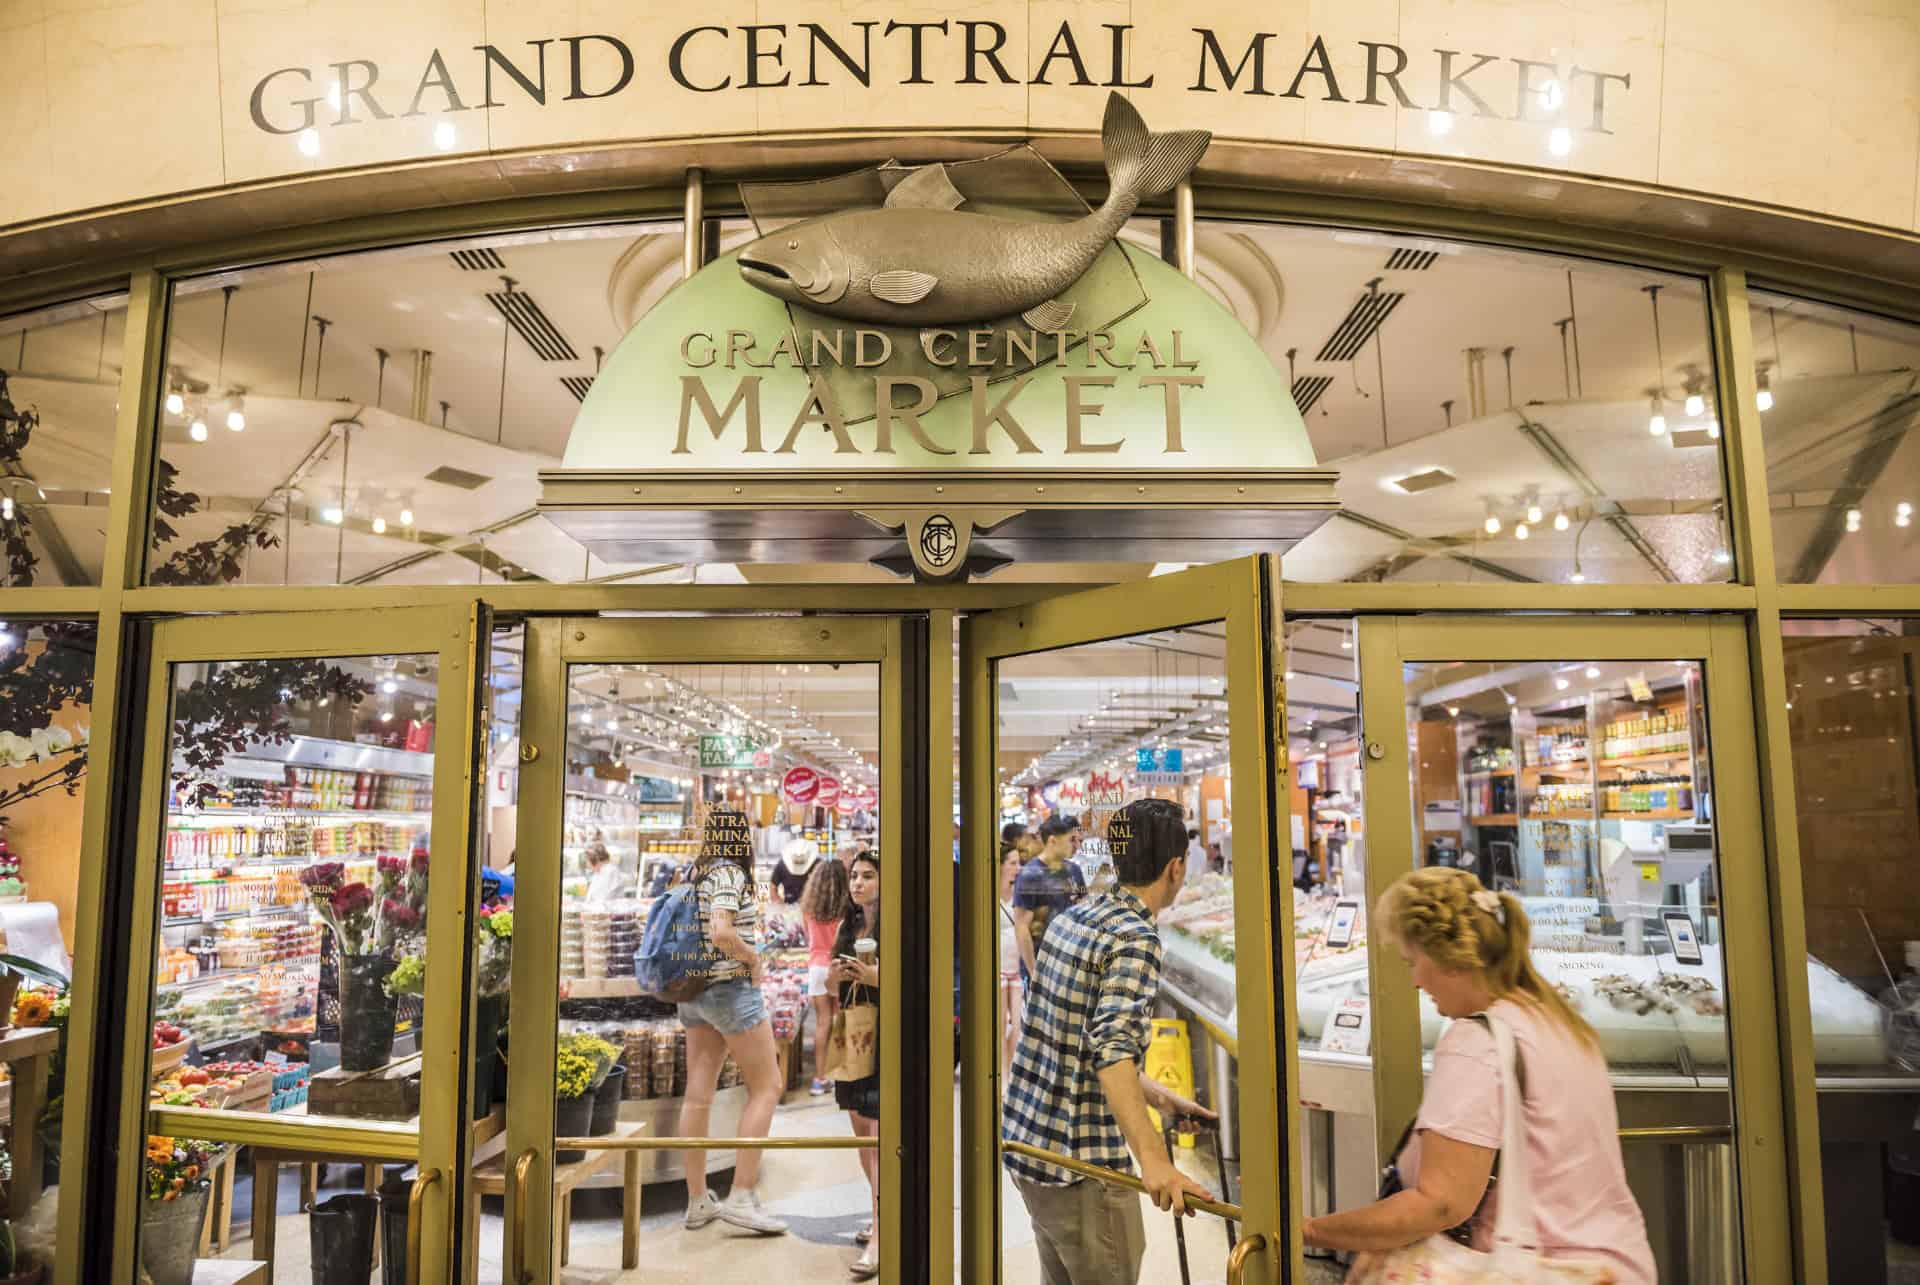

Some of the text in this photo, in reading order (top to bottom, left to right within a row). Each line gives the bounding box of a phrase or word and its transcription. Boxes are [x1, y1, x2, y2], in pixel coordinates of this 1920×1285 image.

[250, 21, 1631, 135] GRAND CENTRAL MARKET
[680, 329, 1200, 371] GRAND CENTRAL
[672, 375, 1206, 455] MARKET
[1080, 791, 1124, 807] GRAND
[692, 844, 752, 857] ARKET
[1080, 841, 1129, 856] MARKET
[1559, 960, 1604, 969] SMOKING
